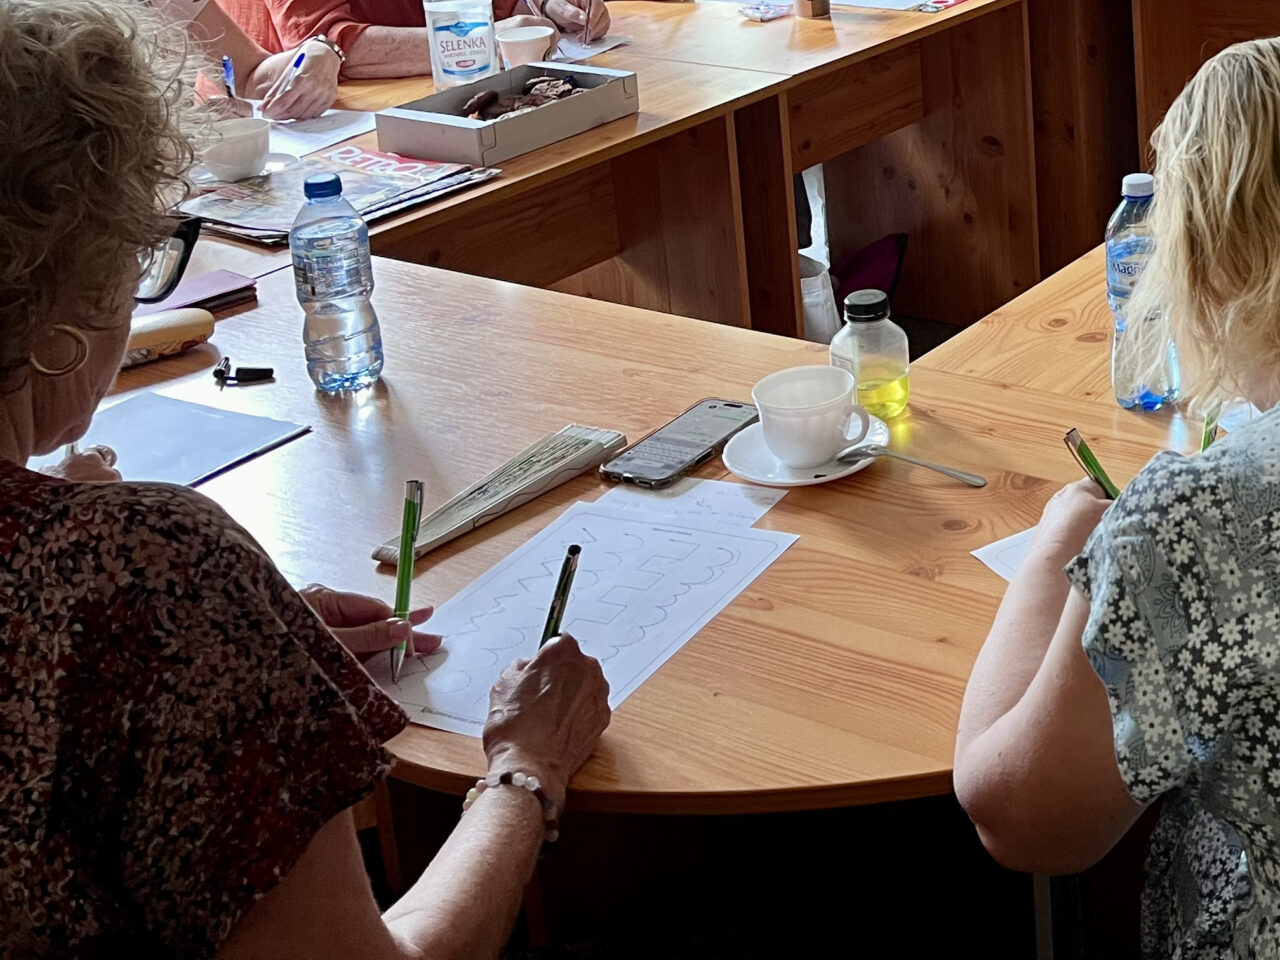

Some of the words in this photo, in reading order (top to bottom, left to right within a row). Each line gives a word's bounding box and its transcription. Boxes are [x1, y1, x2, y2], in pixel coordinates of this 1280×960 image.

[439, 36, 487, 54] SELENKA
[321, 145, 428, 178] RETRO
[1111, 261, 1142, 278] Magn
